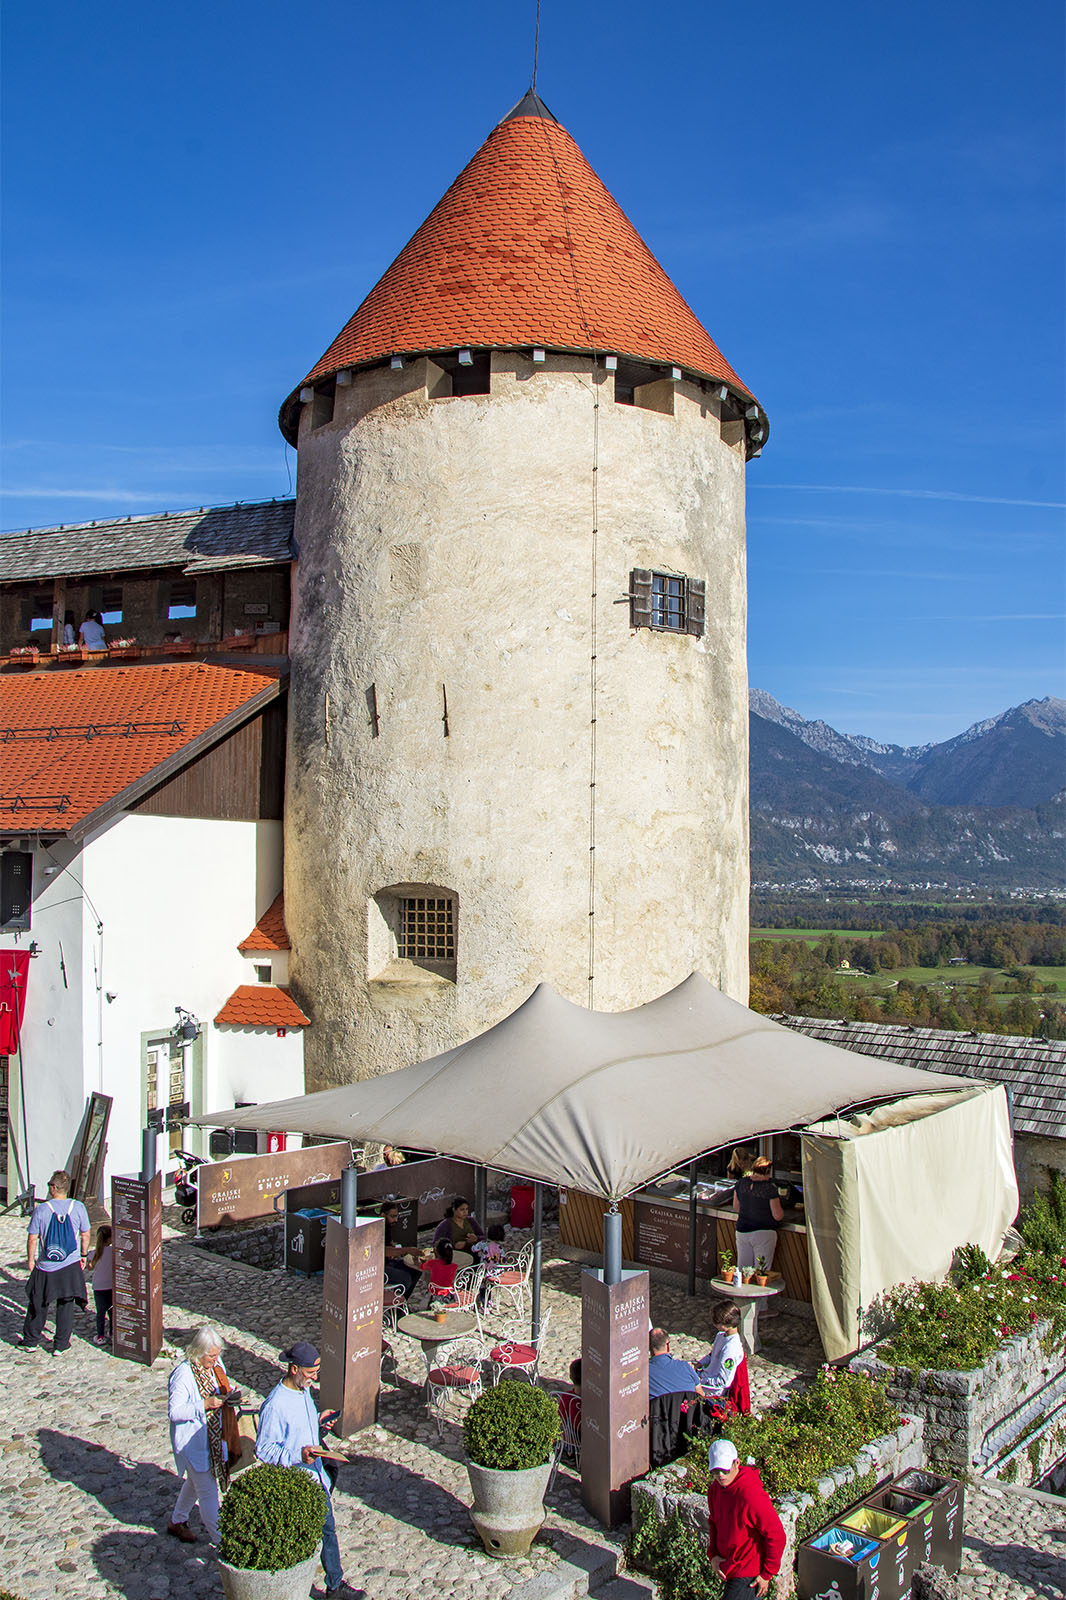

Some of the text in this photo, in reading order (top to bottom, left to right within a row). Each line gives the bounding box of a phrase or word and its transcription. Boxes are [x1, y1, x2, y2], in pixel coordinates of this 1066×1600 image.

[258, 1179, 289, 1191] SHOP
[615, 1296, 645, 1313] GRAJSKA
[615, 1304, 645, 1320] KAVARNA
[353, 1305, 379, 1322] SHOP
